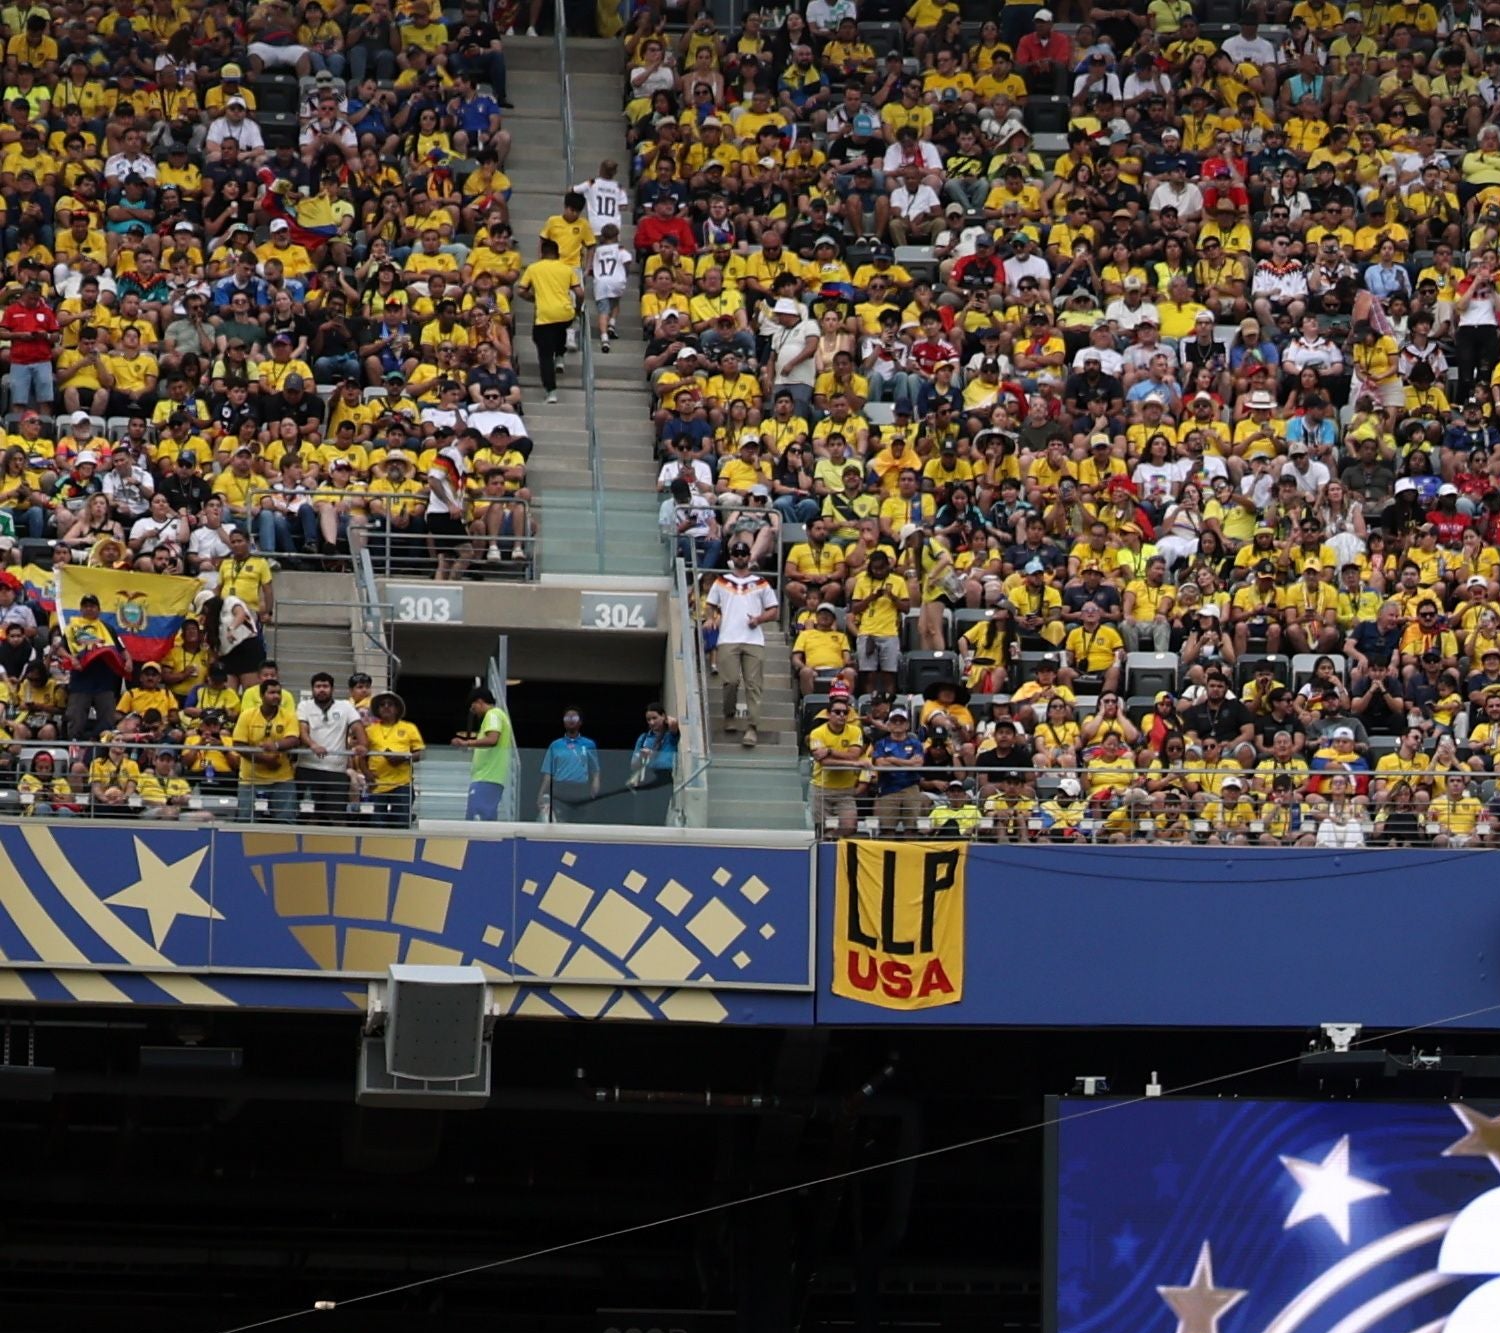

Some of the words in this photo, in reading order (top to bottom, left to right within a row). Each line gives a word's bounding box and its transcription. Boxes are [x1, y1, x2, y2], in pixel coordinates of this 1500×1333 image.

[597, 196, 616, 217] 10
[600, 258, 617, 277] 17
[398, 595, 451, 624] 303
[594, 602, 646, 630] 304
[846, 842, 961, 957] LLP
[847, 951, 954, 999] USA
